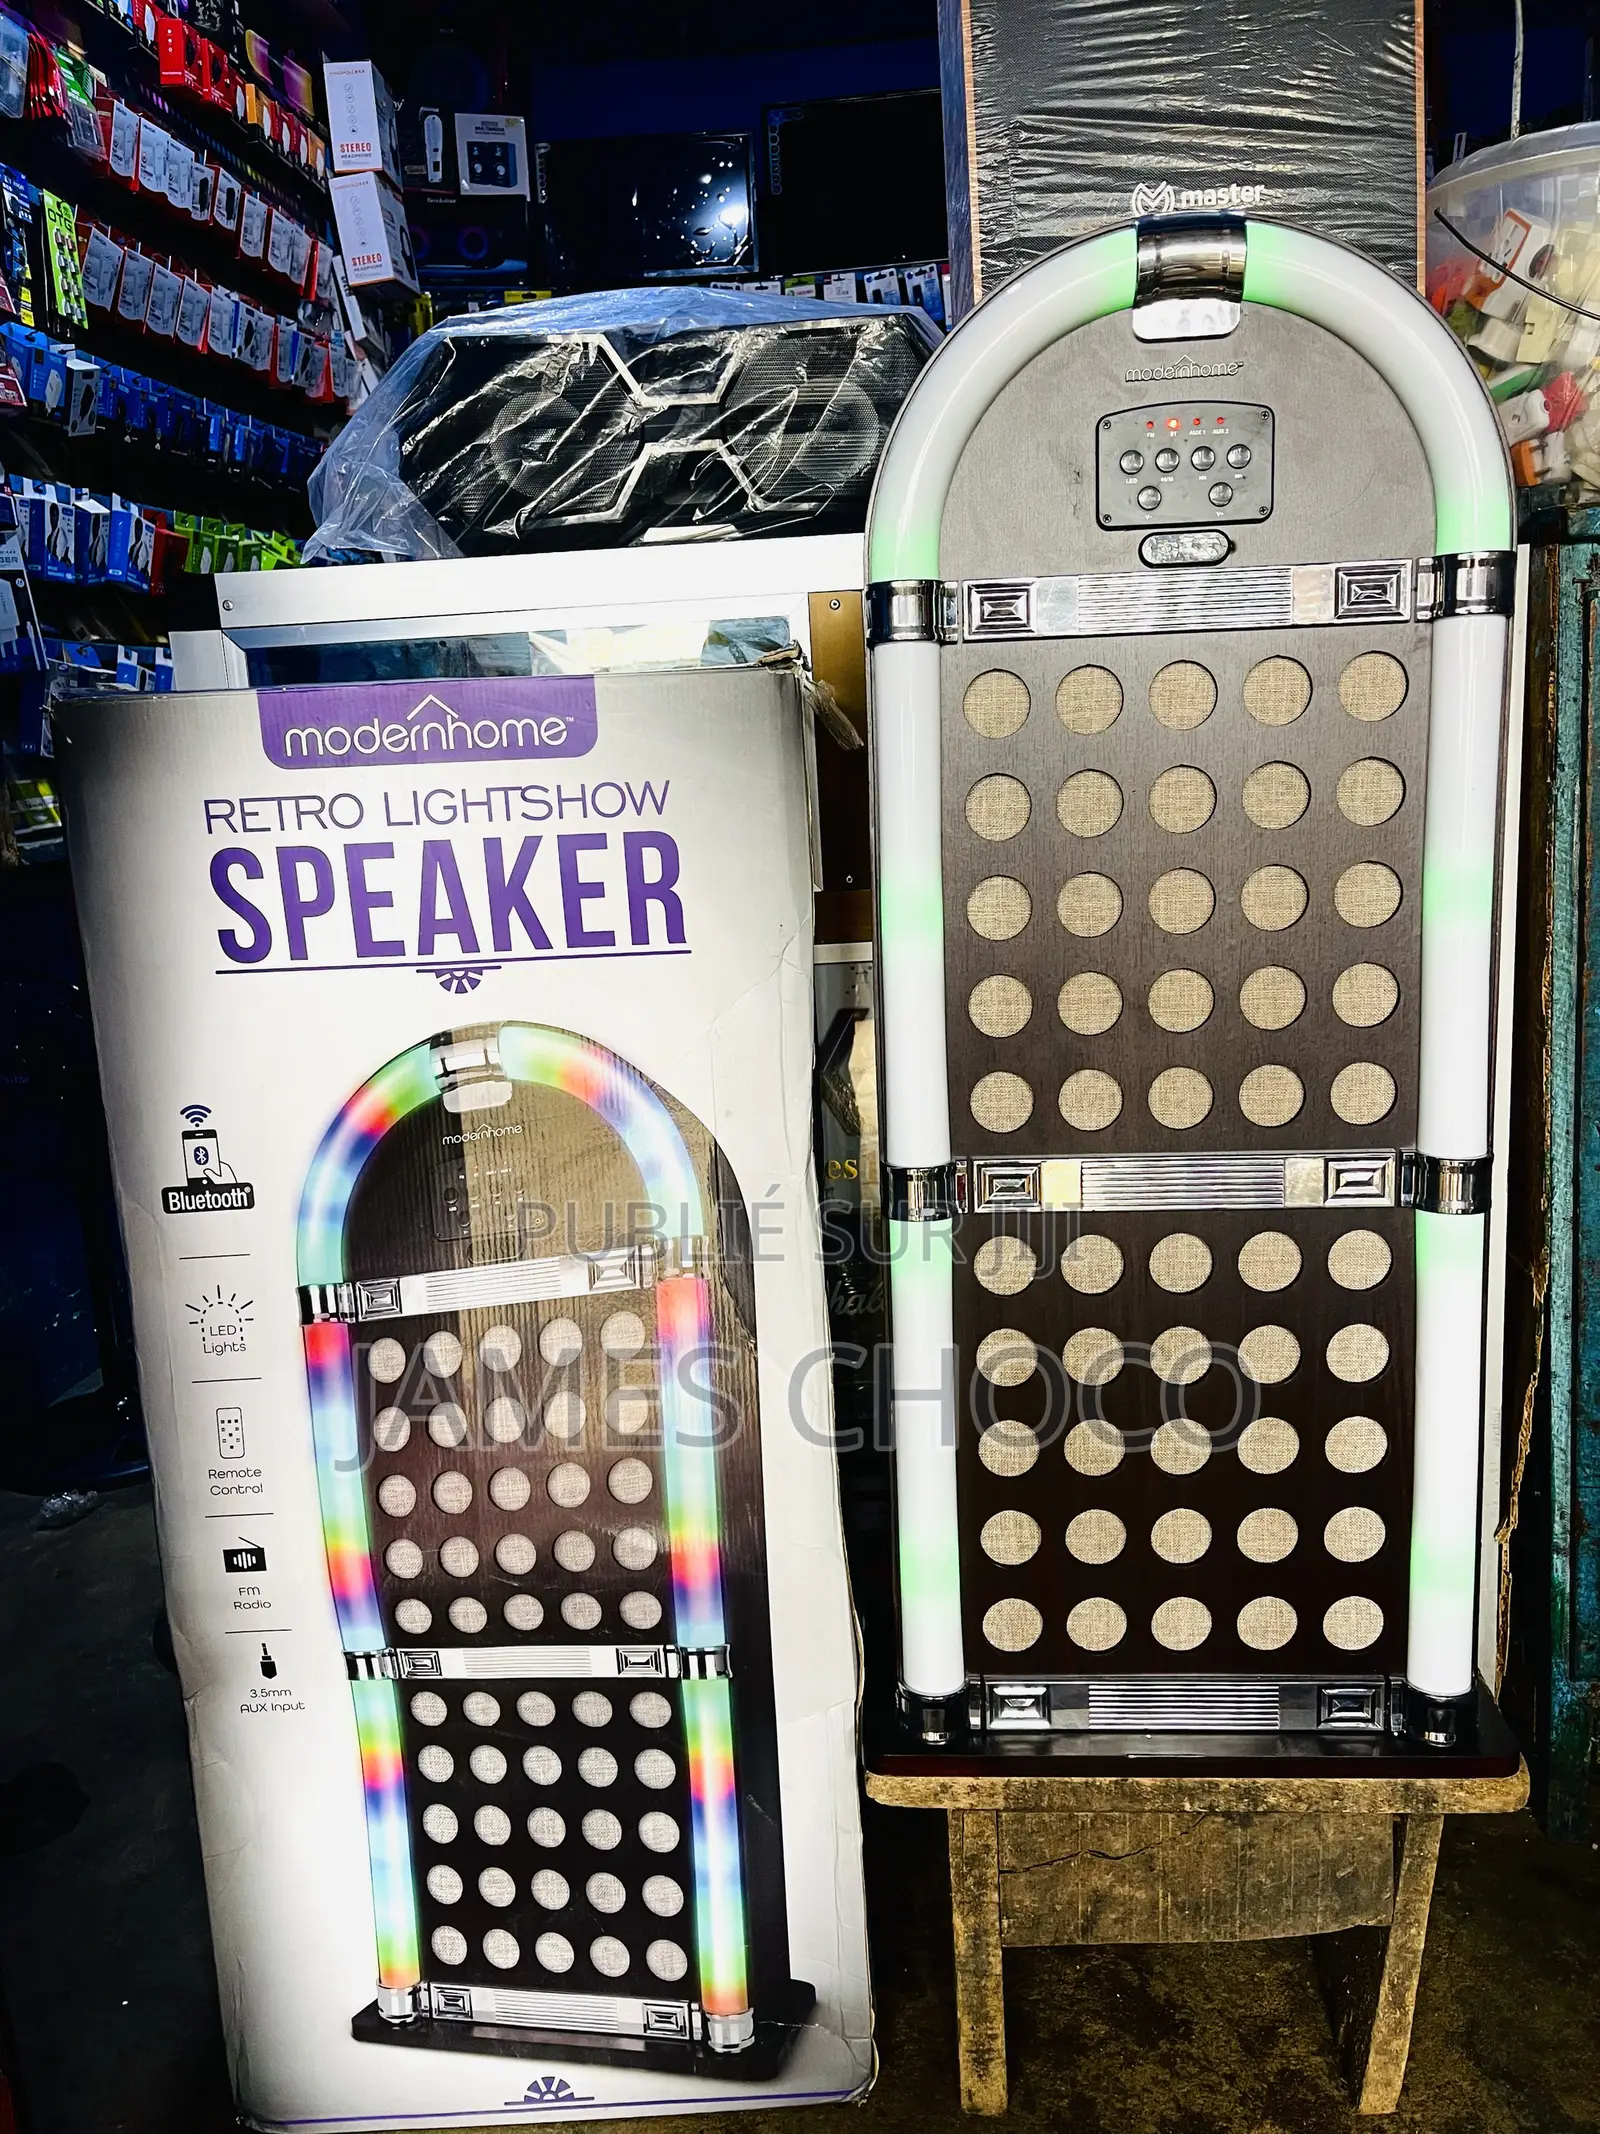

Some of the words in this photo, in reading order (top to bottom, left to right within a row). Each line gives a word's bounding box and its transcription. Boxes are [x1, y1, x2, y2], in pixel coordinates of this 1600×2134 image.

[340, 142, 371, 153] STEREO
[1180, 183, 1265, 207] master
[352, 252, 382, 267] STEREO
[1125, 357, 1239, 381] modernhome
[284, 702, 569, 758] modernhome
[204, 793, 365, 835] RETRO
[384, 780, 671, 827] LIGHTSHOW
[209, 831, 687, 964] SPEAKER
[442, 1124, 523, 1145] modernhome
[168, 1187, 248, 1212] Bluetooth
[209, 1324, 237, 1337] LED
[203, 1341, 247, 1356] Lights
[208, 1467, 262, 1480] Remote
[210, 1483, 264, 1496] Control
[238, 1586, 261, 1596] FM
[233, 1600, 272, 1610] Radio
[250, 1688, 292, 1699] 3.5mm
[240, 1703, 268, 1714] AUX
[271, 1701, 306, 1713] Input
